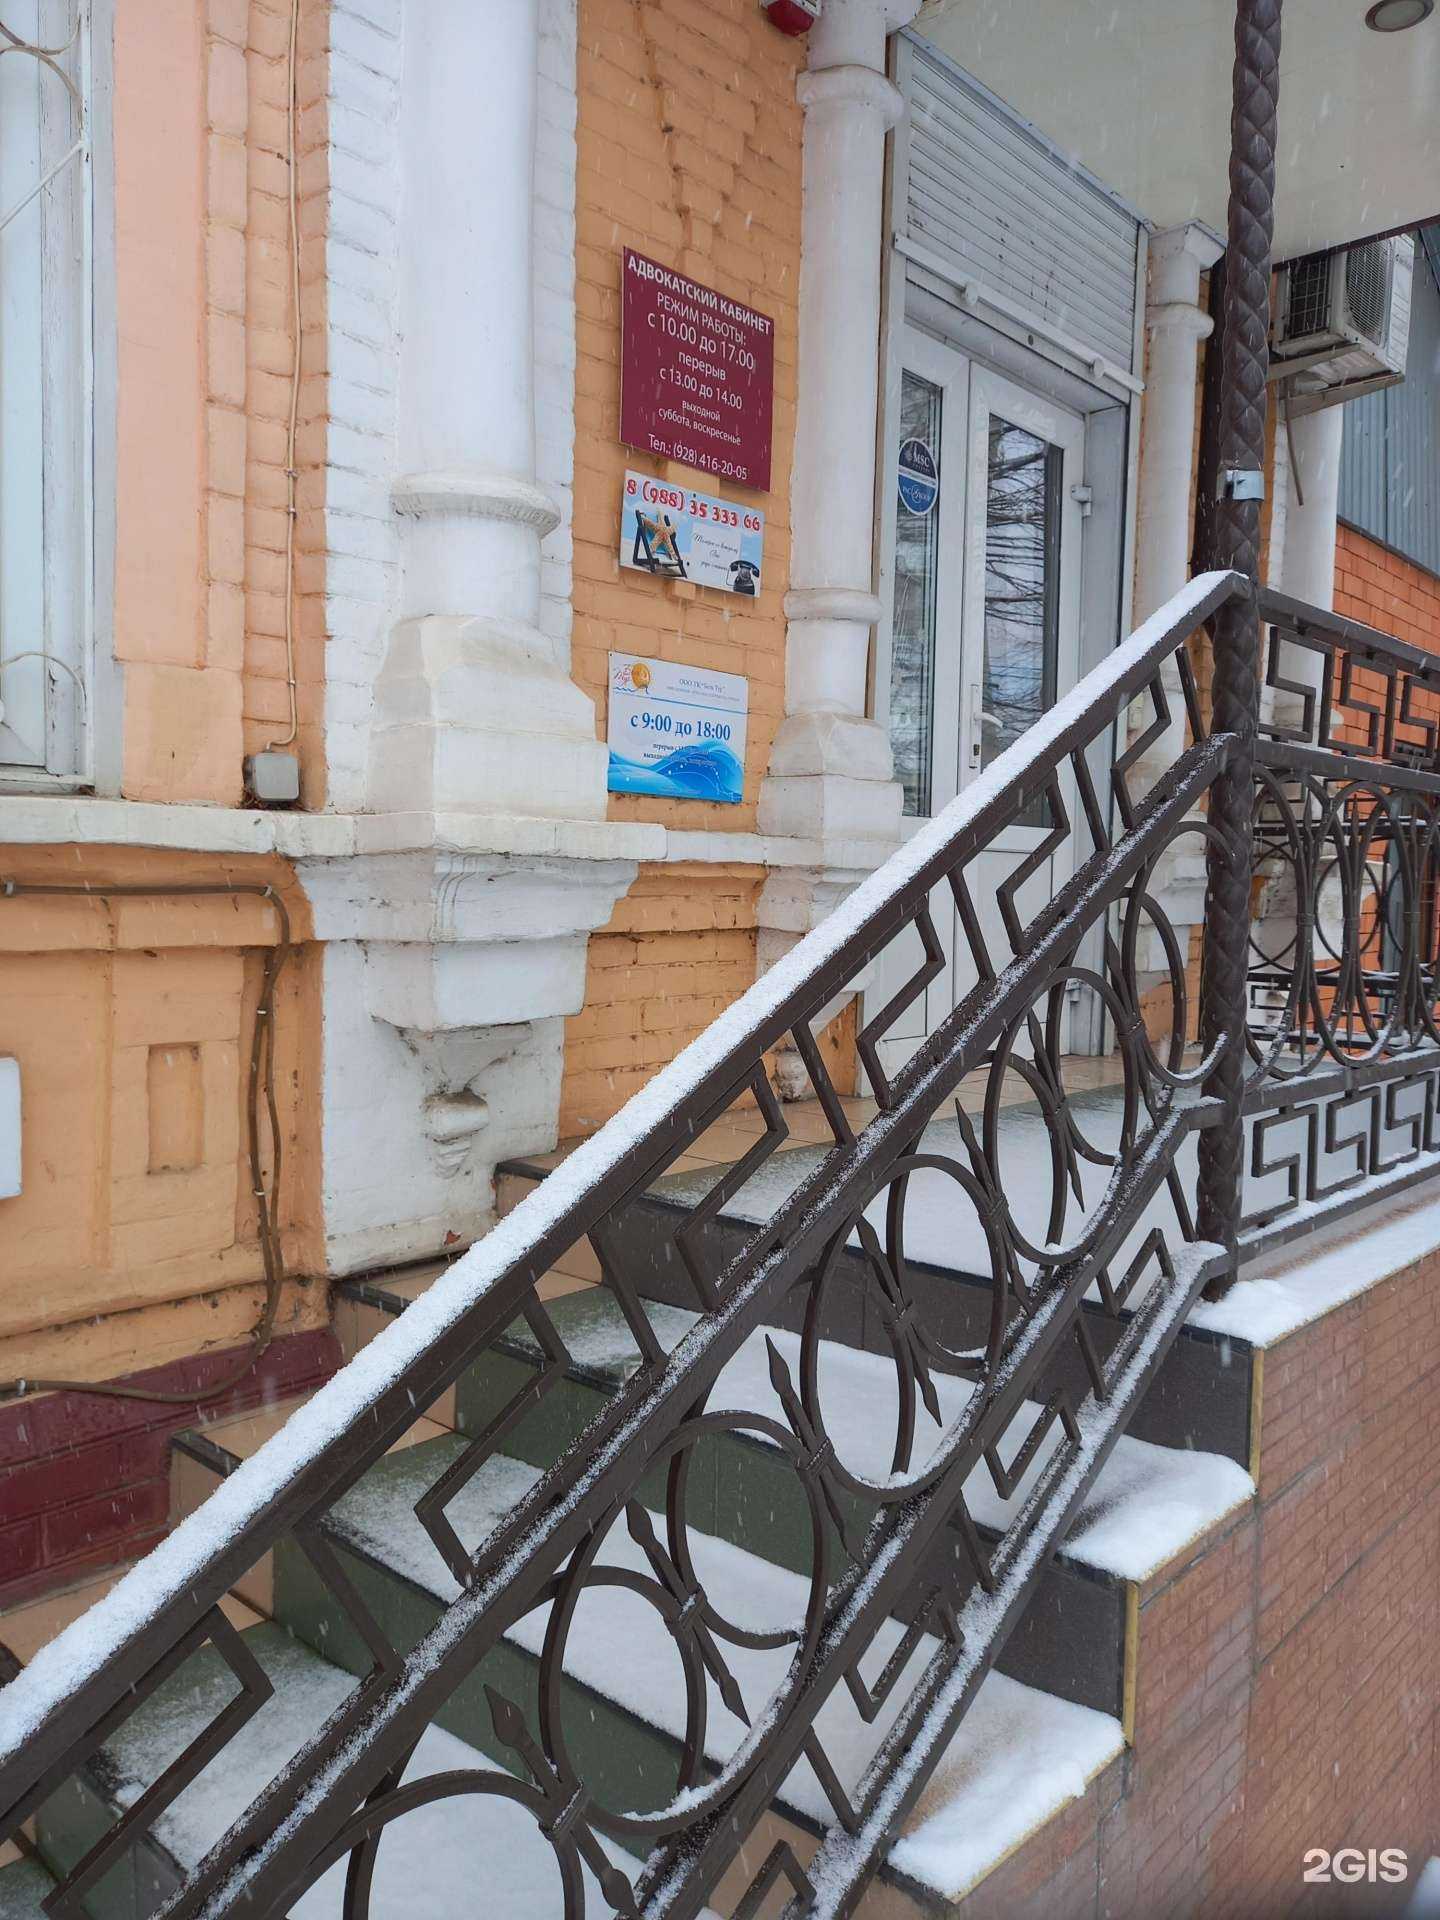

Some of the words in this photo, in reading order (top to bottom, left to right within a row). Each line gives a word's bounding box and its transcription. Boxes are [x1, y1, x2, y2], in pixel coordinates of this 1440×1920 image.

[628, 255, 718, 310] АДВОКАТСКИЙ
[720, 299, 771, 335] КАБИНЕТ
[657, 292, 700, 325] РЕЖИМ
[702, 313, 747, 346] РАБОТЫ:
[660, 314, 696, 344] 10.00
[700, 336, 717, 354] до
[720, 341, 754, 369] 17.00
[678, 352, 726, 380] перерыв
[669, 369, 698, 391] 13.00
[699, 384, 713, 400] до
[716, 388, 743, 410] 14.00
[682, 400, 721, 422] выходной
[658, 408, 692, 429] суббота,
[693, 420, 742, 446] воскресенье
[648, 433, 671, 455] Тел.:
[673, 443, 698, 465] (928)
[699, 454, 748, 480] 416-20-05
[626, 479, 637, 495] 8
[642, 480, 685, 511] (988)
[689, 499, 708, 518] 35
[712, 506, 738, 527] 333
[743, 513, 761, 532] 66
[630, 714, 638, 727] с
[641, 712, 672, 732] 9:00
[675, 721, 692, 738] до
[697, 720, 731, 741] 18:00
